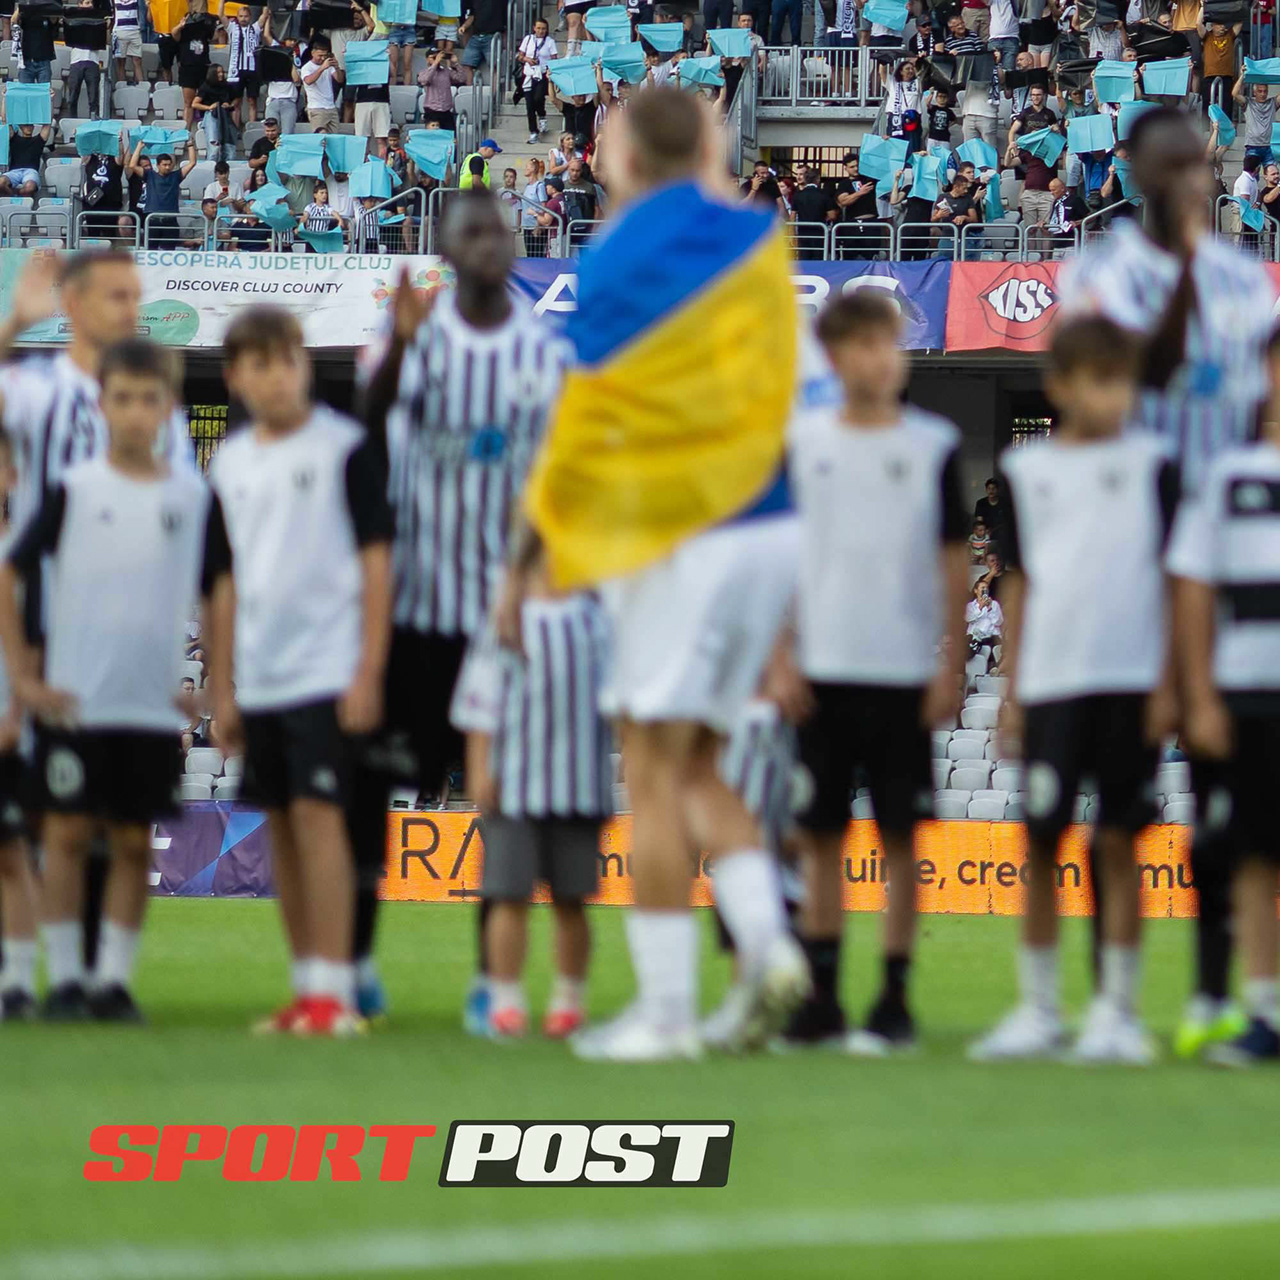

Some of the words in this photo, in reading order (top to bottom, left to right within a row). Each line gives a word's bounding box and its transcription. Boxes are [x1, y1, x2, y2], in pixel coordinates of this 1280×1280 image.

[134, 250, 242, 270] ESCOPERĂ
[248, 255, 335, 275] JUDEȚUL
[343, 256, 392, 271] CLUJ
[165, 279, 239, 294] DISCOVER
[242, 281, 279, 294] CLUJ
[282, 282, 343, 295] COUNTY
[988, 279, 1054, 322] KISS
